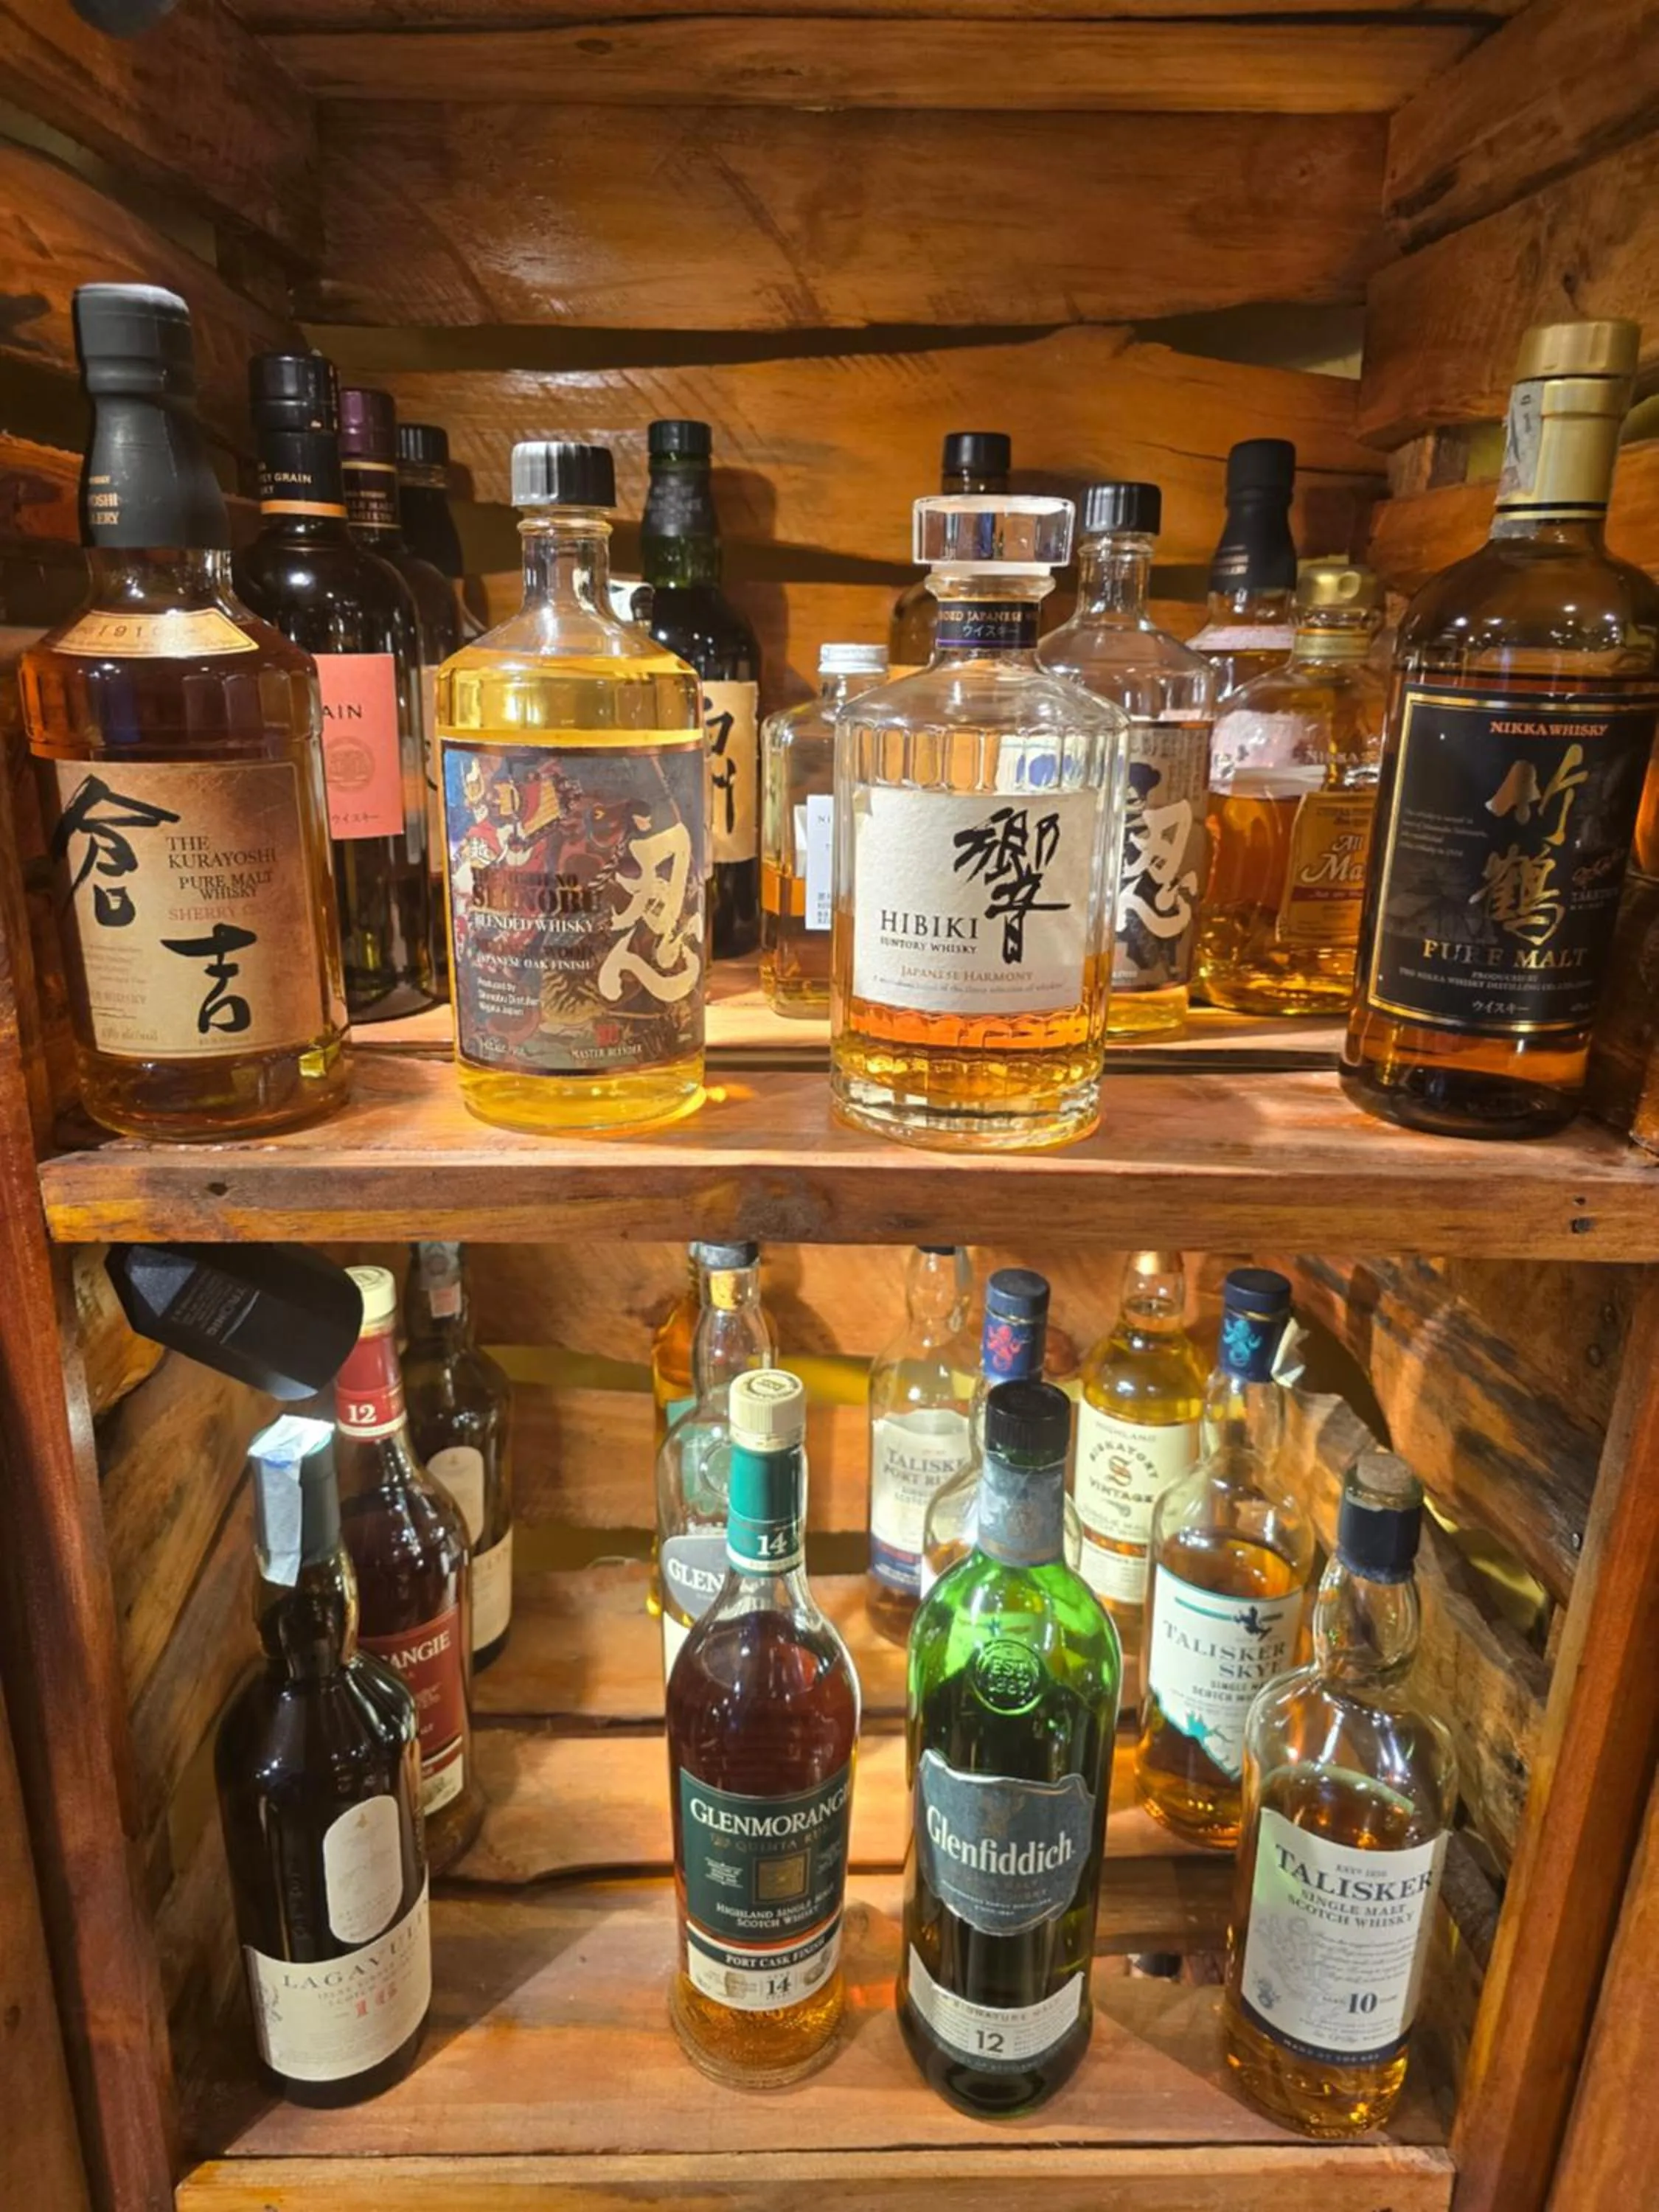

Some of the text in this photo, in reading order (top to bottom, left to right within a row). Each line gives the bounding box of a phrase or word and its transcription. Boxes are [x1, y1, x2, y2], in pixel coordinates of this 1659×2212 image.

[273, 472, 313, 484] GRAIN
[1489, 720, 1610, 737] NIKKA WHISKY
[166, 835, 210, 852] THE
[1468, 742, 1591, 946] 竹鶴
[168, 846, 277, 871] KURAYOSHI
[178, 869, 275, 890] PURE MALT
[953, 806, 1072, 965] 響
[199, 885, 259, 902] WHISKY
[167, 905, 237, 922] SHERRY
[474, 912, 595, 933] BLENDED WHISKY
[880, 909, 979, 941] HIBIKI
[880, 936, 978, 955] SUNTORY WHISKY
[524, 958, 549, 970] OAK
[552, 959, 592, 971] FINISH
[1513, 946, 1589, 970] MALT
[900, 964, 1034, 984] JAPANESE HARMONY
[1472, 999, 1531, 1016] ウイスキー
[347, 1402, 378, 1425] 12
[1089, 1475, 1155, 1505] VINTAGE
[757, 1531, 789, 1557] 14
[379, 1630, 452, 1670] ANGIE
[1163, 1620, 1287, 1662] TALISKER
[1219, 1660, 1284, 1680] SKYE
[1192, 1685, 1233, 1703] SCOTCH
[1210, 1679, 1249, 1693] SINGLE
[926, 1804, 1073, 1877] Glenfiddich
[1275, 1843, 1433, 1903] TALISKER
[716, 1902, 773, 1919] HIGHLAND
[776, 1899, 812, 1918] SINGLE
[1287, 1893, 1416, 1930] SCOTCH WHISKY
[1301, 1888, 1408, 1917] SINGLE MALT
[737, 1905, 820, 1930] SCOTCH WHISKY
[726, 1936, 827, 1969] PORT CASK FINISH
[765, 1976, 792, 1997] 14
[953, 1999, 1026, 2023] SIGNATURE
[1347, 1992, 1378, 2015] 10
[975, 2029, 1006, 2054] 12
